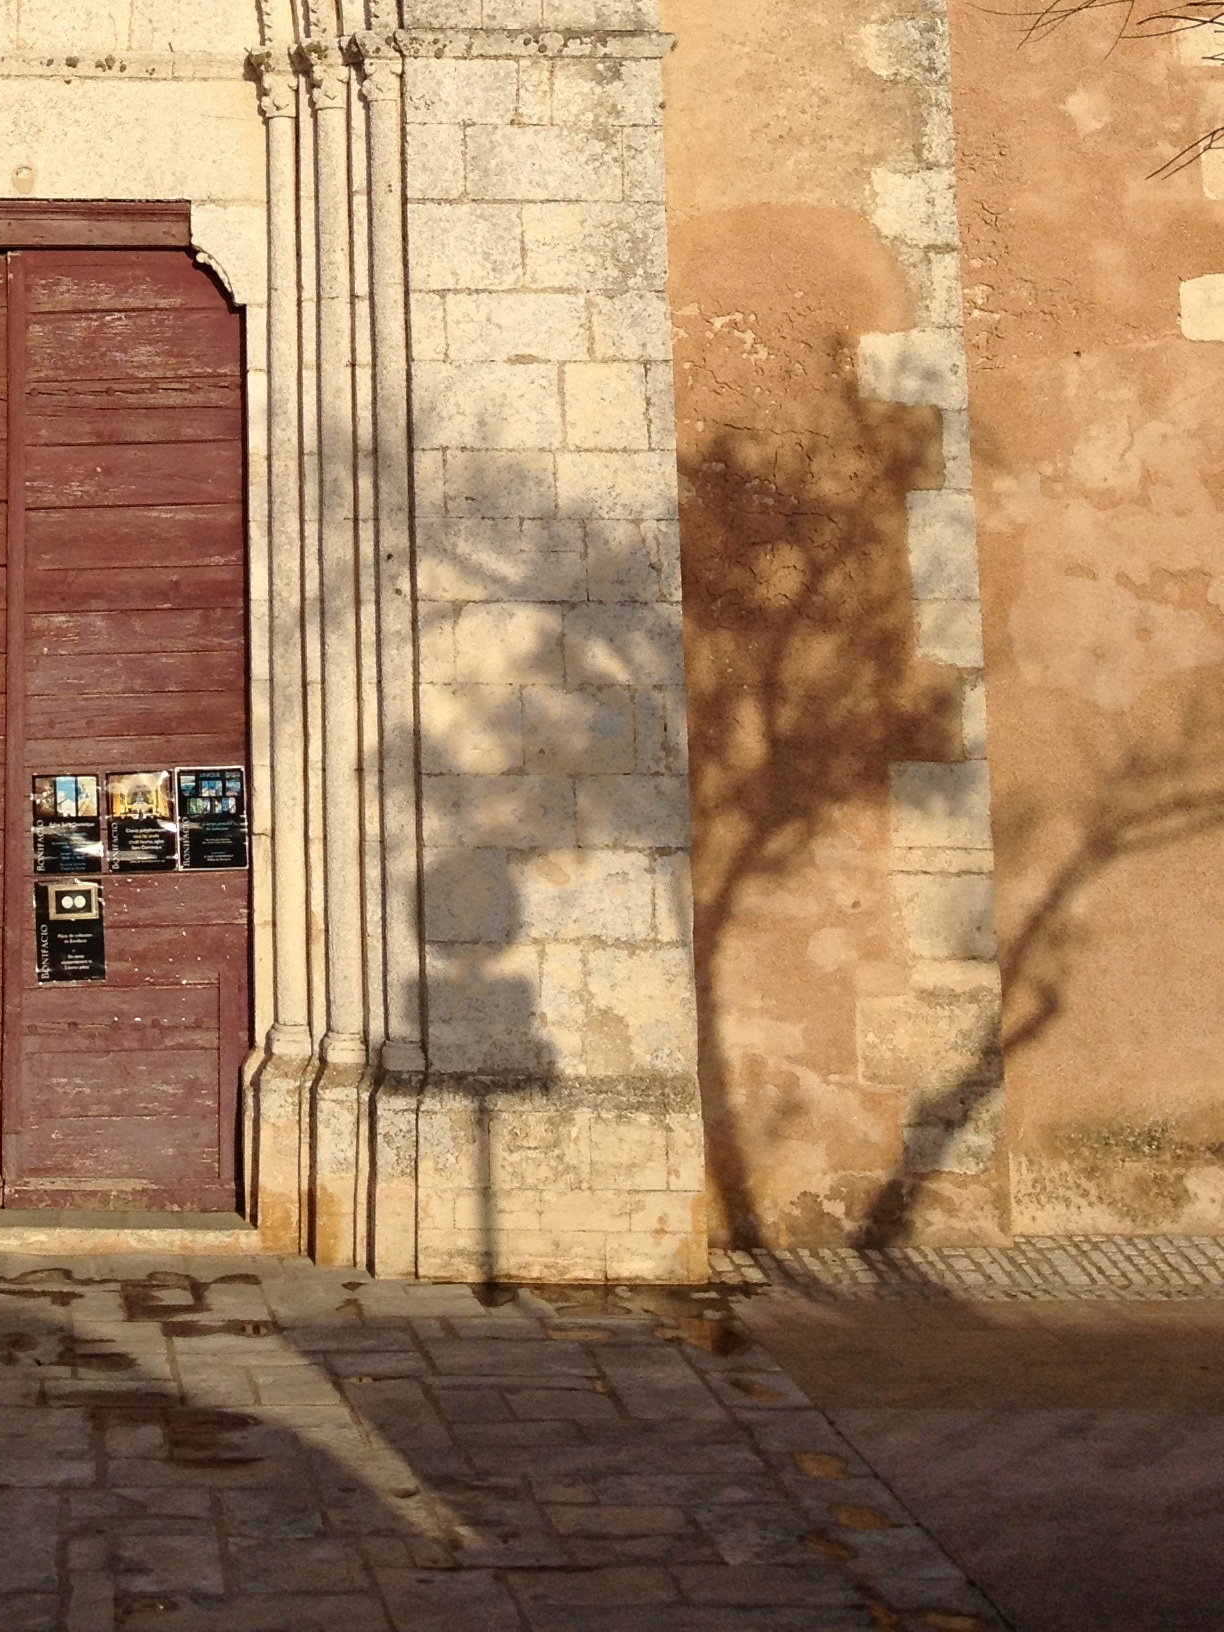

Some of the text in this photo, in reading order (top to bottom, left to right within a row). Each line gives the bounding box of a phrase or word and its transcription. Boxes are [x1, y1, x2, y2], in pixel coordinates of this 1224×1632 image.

[36, 819, 45, 872] BONIFACIO
[111, 822, 120, 870] BONIFACIO
[182, 816, 191, 867] BONIFACIO
[40, 924, 50, 979] BONIFACIO
